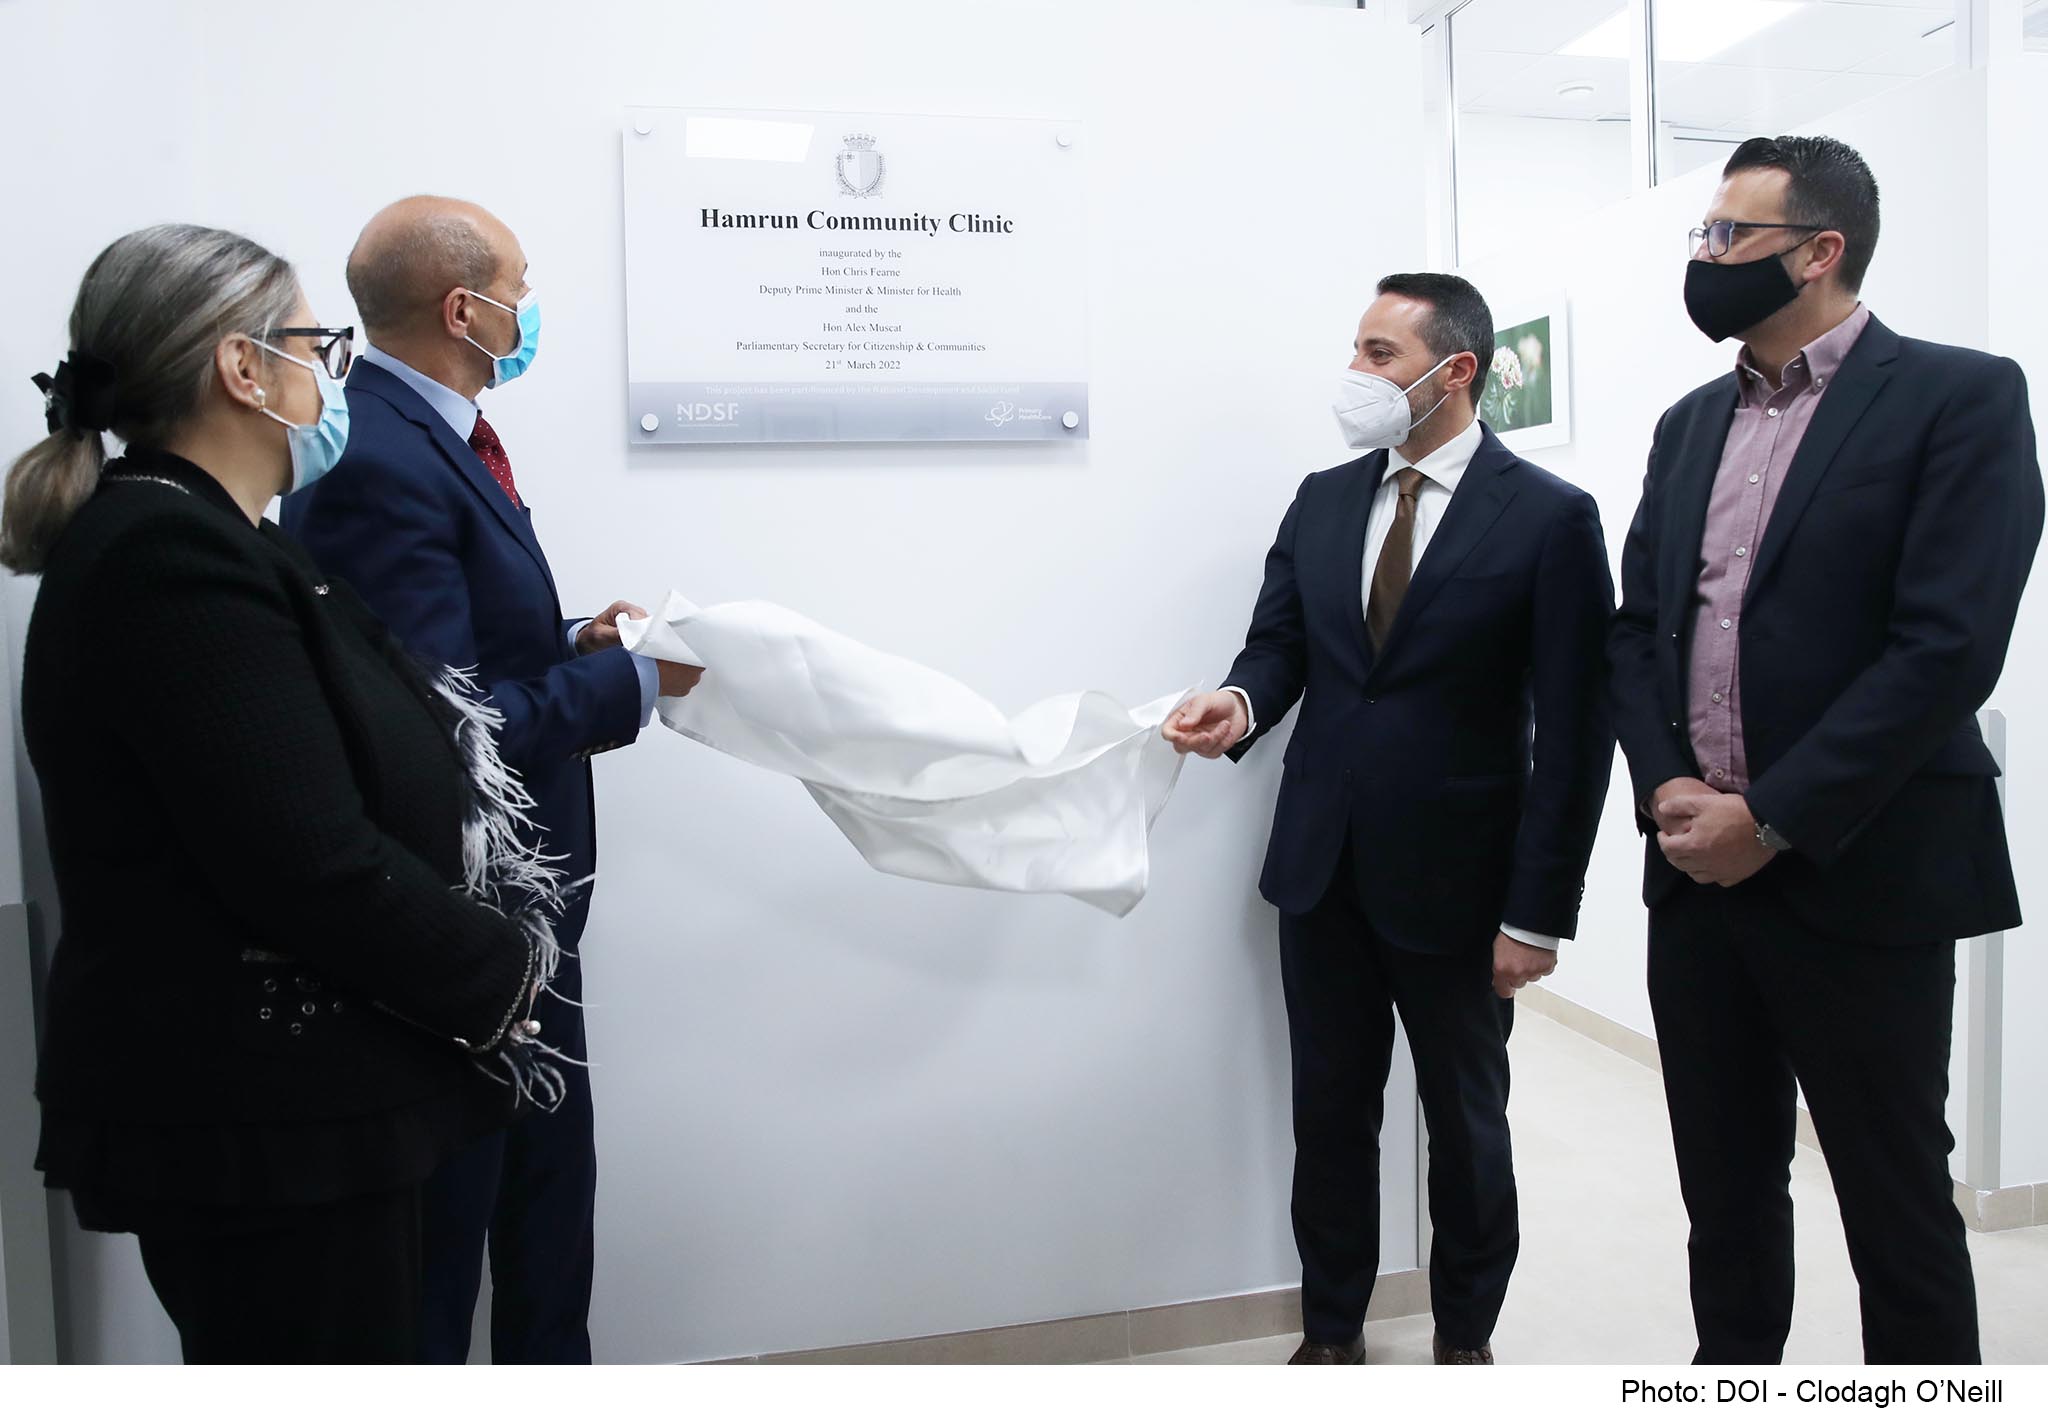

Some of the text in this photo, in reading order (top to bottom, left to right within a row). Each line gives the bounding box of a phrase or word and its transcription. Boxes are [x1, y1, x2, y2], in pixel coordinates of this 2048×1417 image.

[701, 208, 1014, 238] Hamrun Community Clinic
[819, 248, 902, 261] inaugurated by the
[821, 266, 901, 277] Hon Chris Fearne
[759, 284, 962, 297] Deputy Prime Minister & Minister for Health
[845, 304, 879, 314] and the
[823, 322, 902, 333] Hon Alex Muscat
[736, 341, 986, 353] Parliamentary Secretary for Citizenship & Communities
[825, 359, 901, 370] 21st March 2022
[676, 402, 739, 421] NDSF
